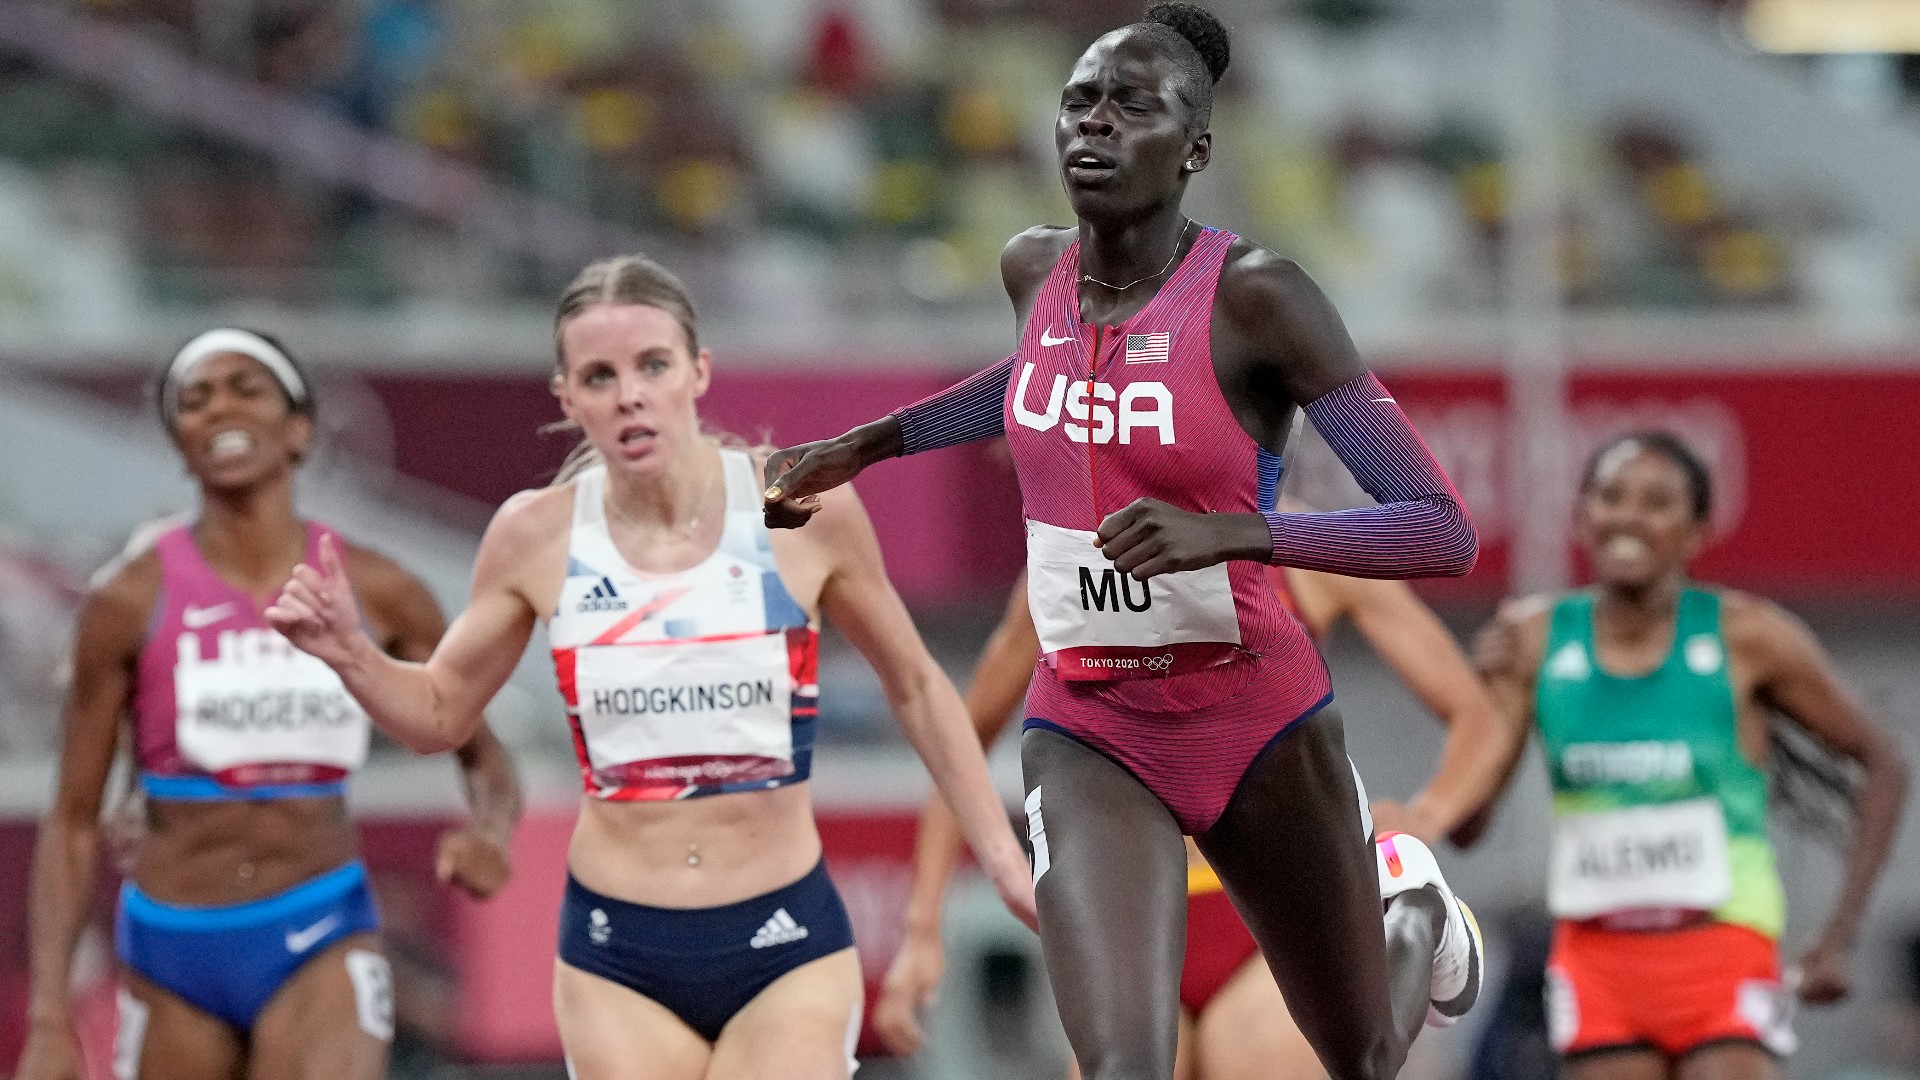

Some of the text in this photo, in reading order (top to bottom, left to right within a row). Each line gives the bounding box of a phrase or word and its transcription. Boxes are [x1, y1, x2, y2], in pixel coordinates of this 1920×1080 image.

[1012, 361, 1176, 445] USA
[1079, 566, 1152, 613] MU
[1080, 658, 1140, 669] TOKYO 2020
[593, 679, 773, 715] HODGKINSON
